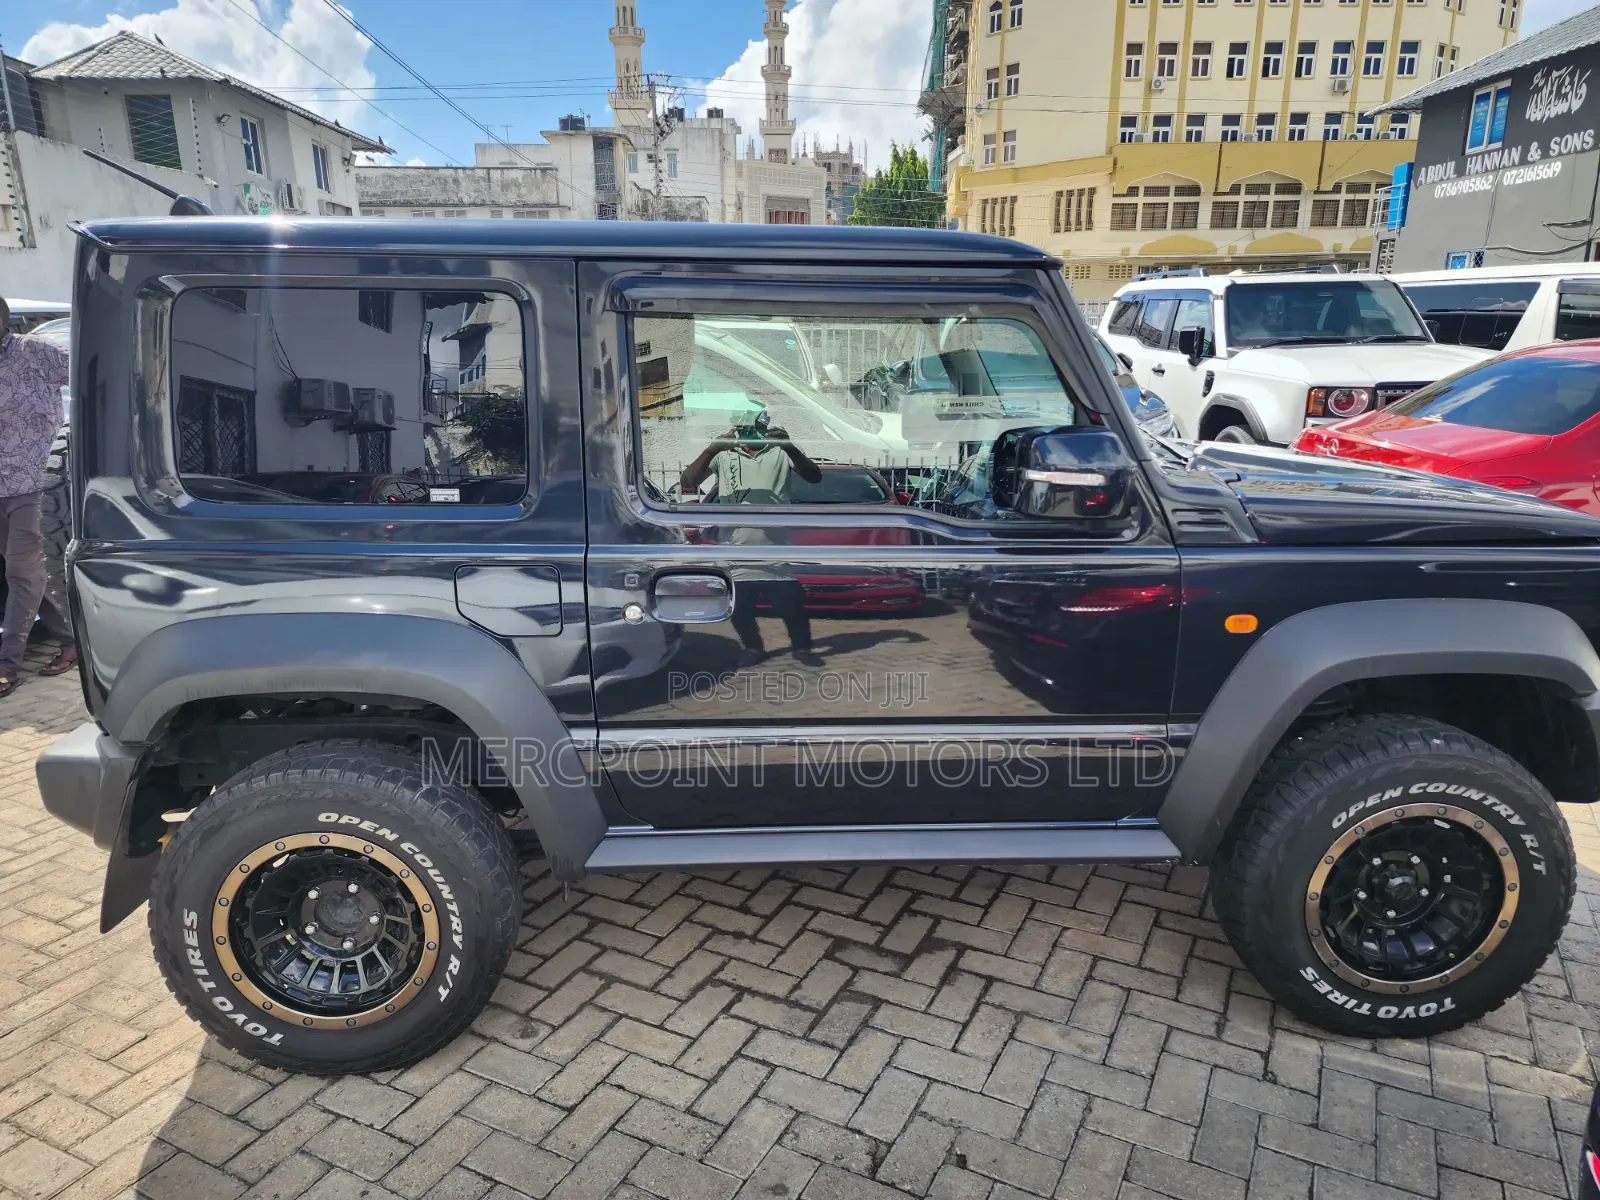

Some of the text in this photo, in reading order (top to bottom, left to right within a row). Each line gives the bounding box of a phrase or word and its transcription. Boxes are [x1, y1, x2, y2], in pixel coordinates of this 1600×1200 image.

[1417, 129, 1594, 186] ABDUL HANNAN & SONS
[1434, 175, 1493, 198] 0786905862
[1504, 162, 1562, 186] 0721615619
[1331, 782, 1547, 875] OPEN COUNTRY R/T
[317, 812, 465, 1003] OPEN COUNTRY R/T
[182, 908, 284, 1046] TOYO TIRES
[1299, 966, 1456, 1020] TOYO TIRES
